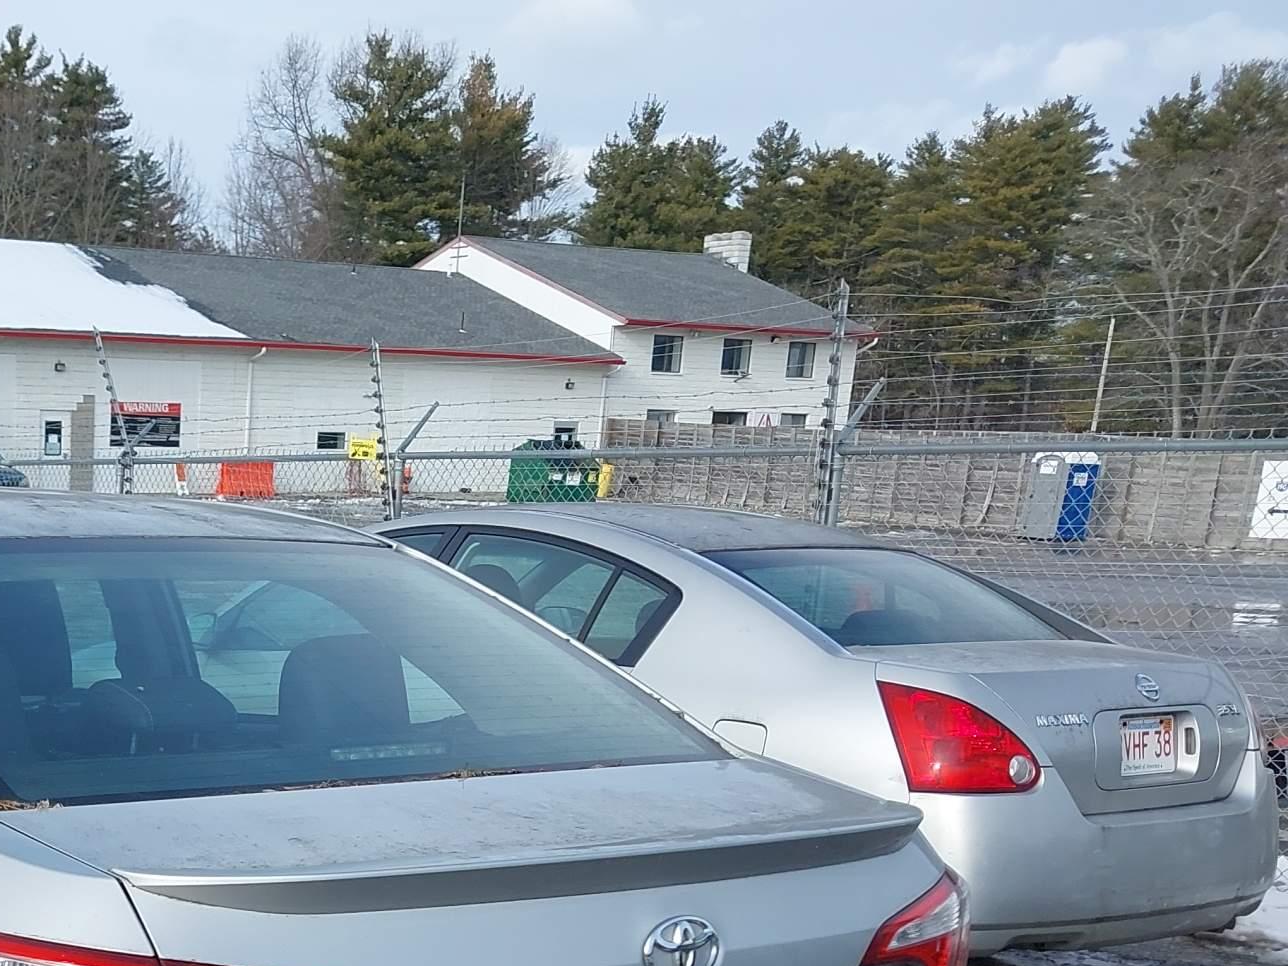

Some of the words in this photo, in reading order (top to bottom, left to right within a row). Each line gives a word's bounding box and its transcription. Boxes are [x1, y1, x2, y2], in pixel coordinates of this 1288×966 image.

[123, 402, 169, 413] WARNING
[1036, 713, 1089, 727] MAXIMA
[1124, 731, 1149, 761] VHF
[1154, 730, 1172, 758] 38
